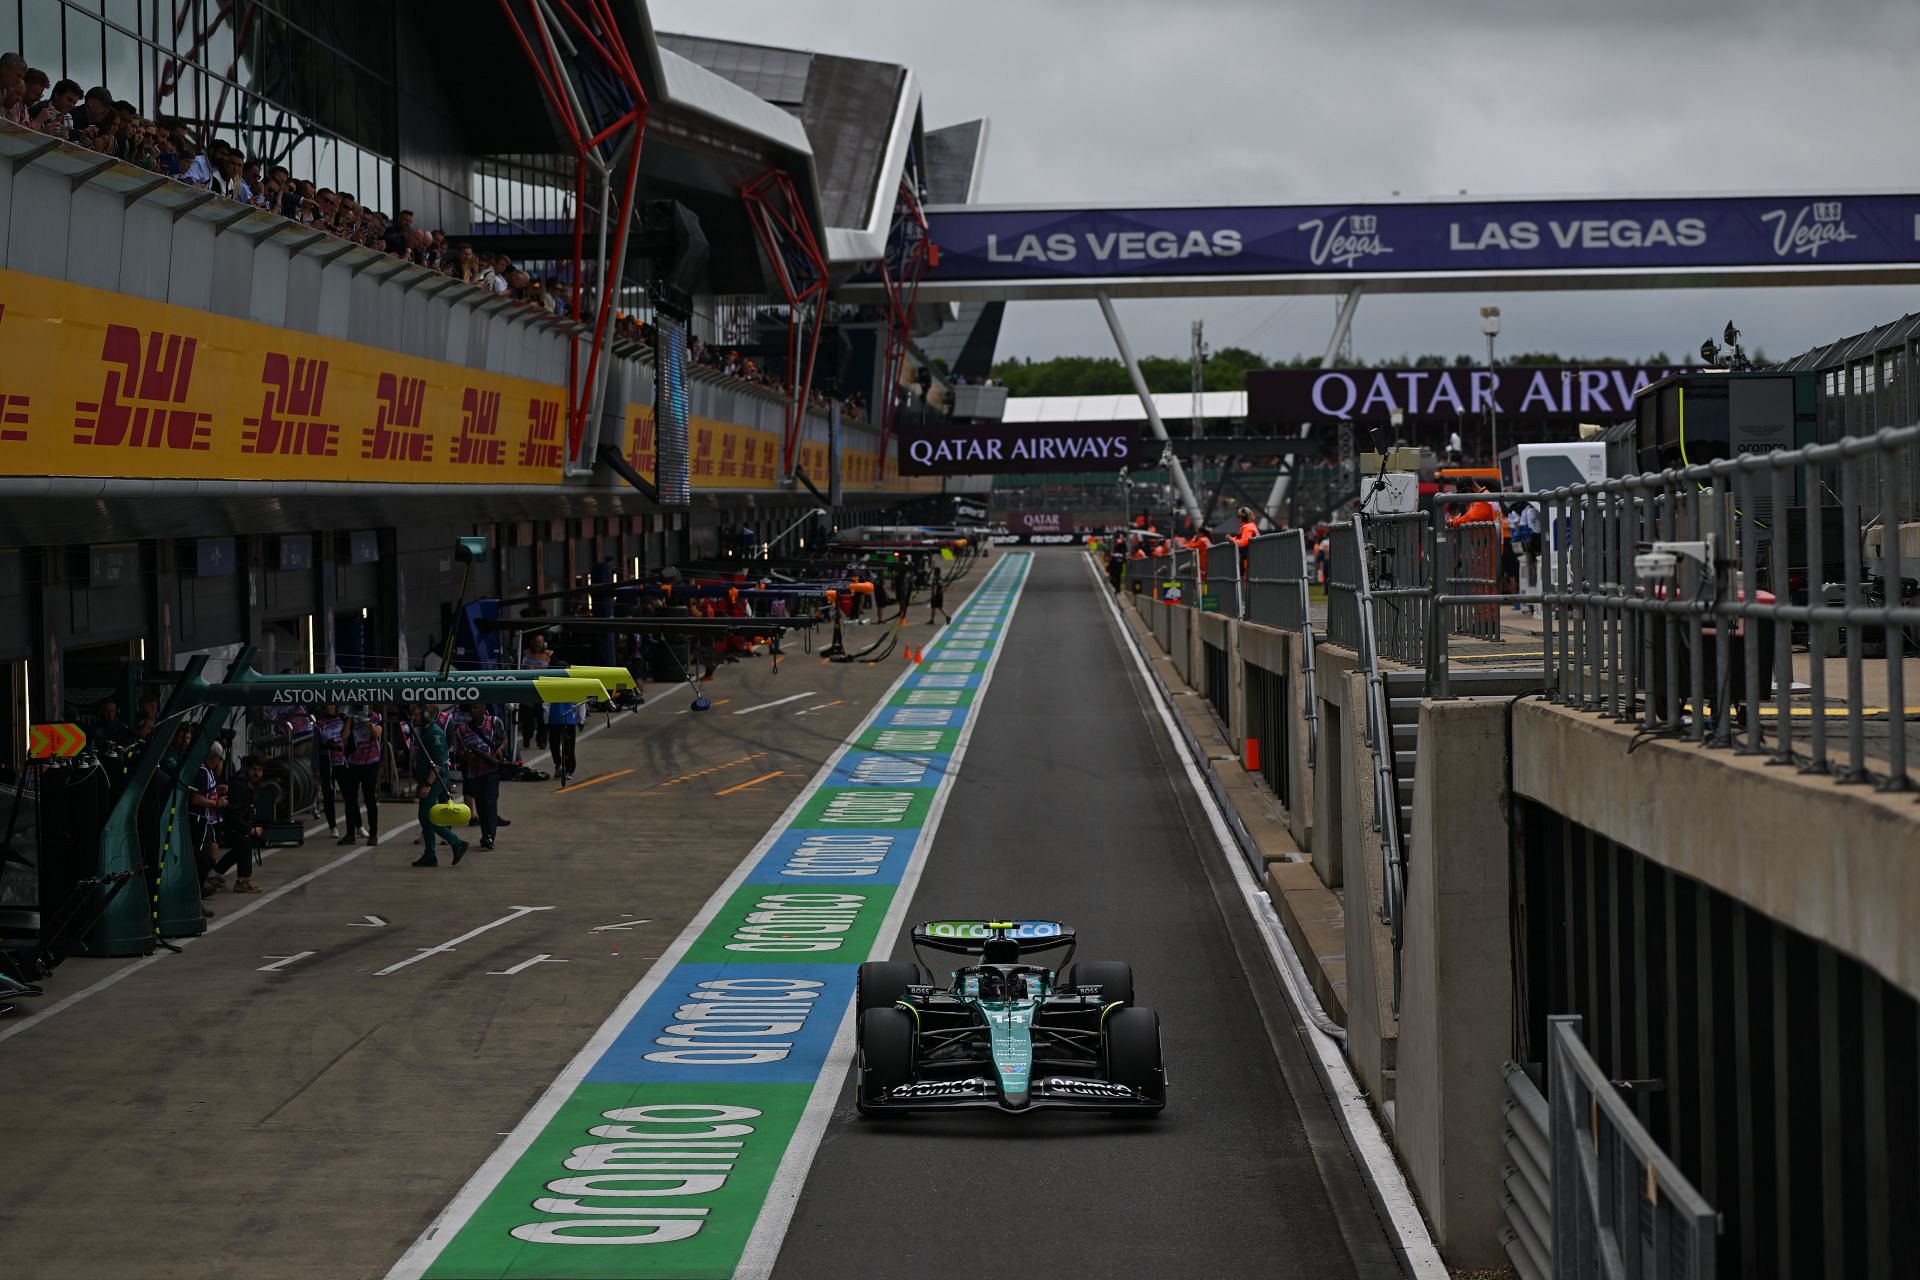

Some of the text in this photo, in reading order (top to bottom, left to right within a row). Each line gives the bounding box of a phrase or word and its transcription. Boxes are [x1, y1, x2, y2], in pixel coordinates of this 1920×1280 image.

[987, 229, 1243, 262] LAS VEGAS
[1299, 216, 1393, 267] Vegas
[1450, 218, 1707, 250] LAS VEGAS
[1761, 206, 1857, 257] Vegas
[94, 323, 198, 449] DHL
[1311, 371, 1504, 420] QATAR
[256, 352, 329, 455] DHL
[371, 372, 427, 462] DHL
[910, 439, 1003, 466] QATAR
[1010, 436, 1128, 460] AIRWAYS
[1023, 514, 1060, 527] QATAR
[273, 687, 480, 703] ASTON MARTIN aramco
[723, 893, 867, 952] aramco
[911, 987, 930, 995] BOSS
[1080, 987, 1099, 995] BOSS
[642, 978, 826, 1065] aramco
[992, 1014, 1026, 1024] 14
[893, 1078, 976, 1097] aramco
[1051, 1078, 1132, 1097] aramco
[508, 1104, 763, 1244] aramco
